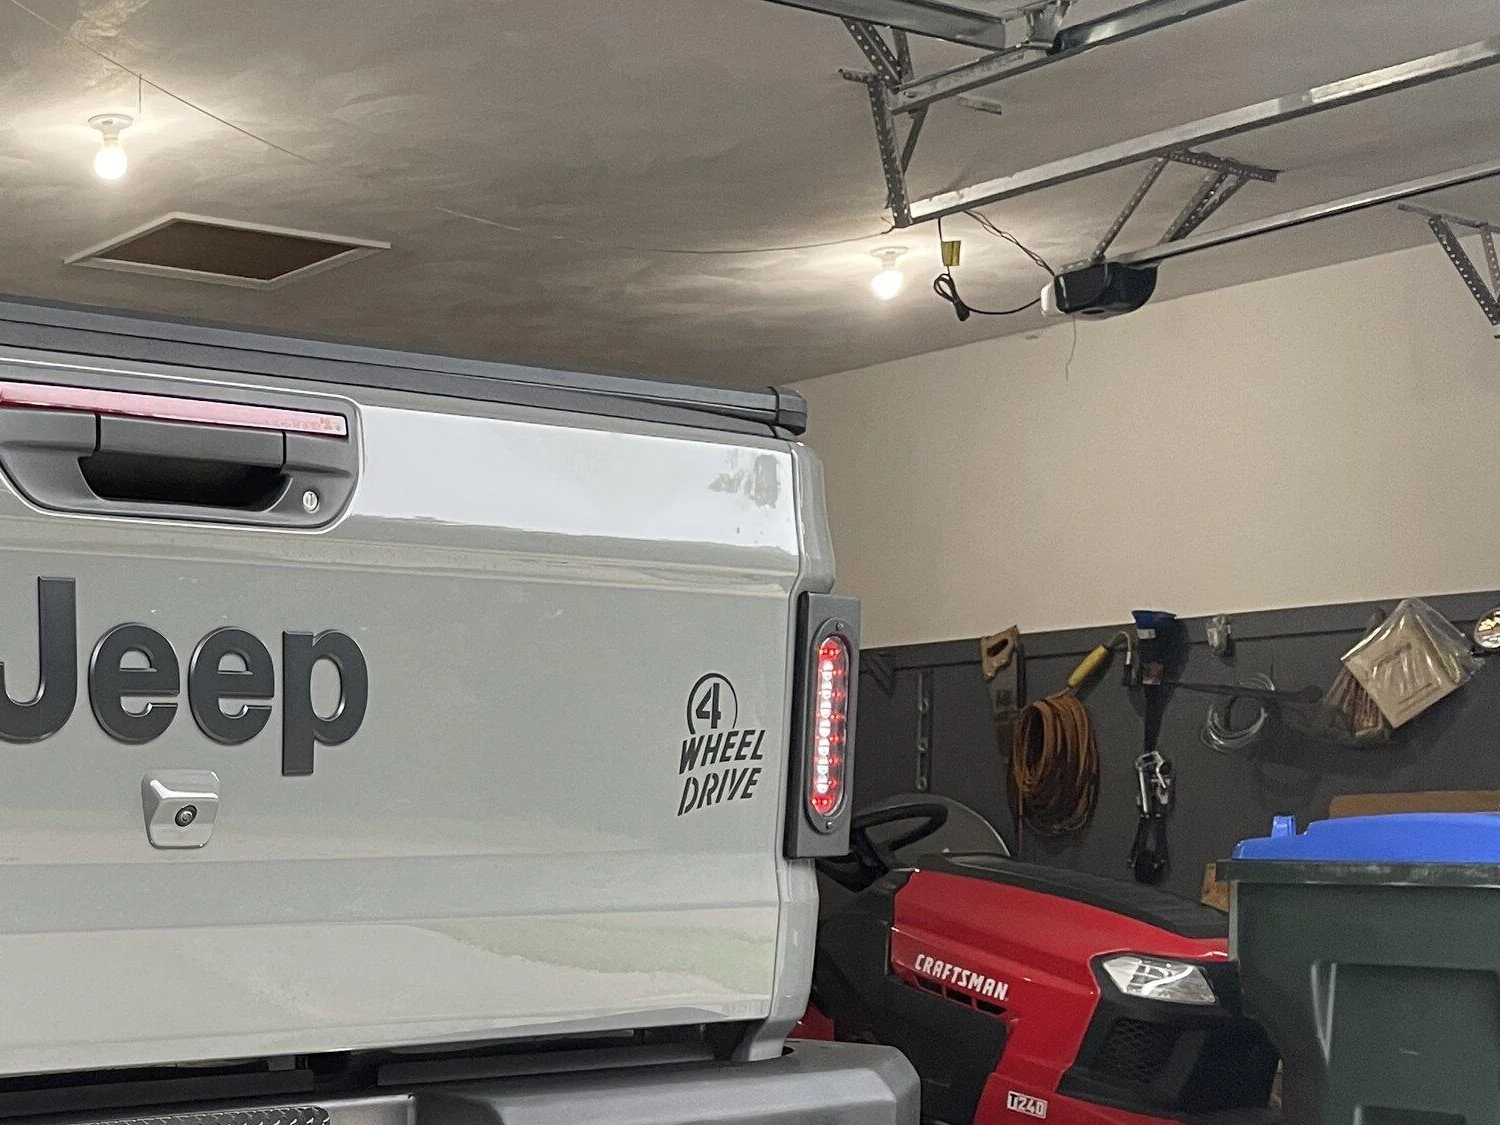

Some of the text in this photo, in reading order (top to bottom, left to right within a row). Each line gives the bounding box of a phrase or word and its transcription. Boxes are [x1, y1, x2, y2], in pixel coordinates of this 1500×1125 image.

[695, 682, 722, 730] 4
[678, 729, 766, 775] WHEEL
[677, 767, 762, 817] DRIVE
[914, 953, 1009, 1001] CRAFTSMAN
